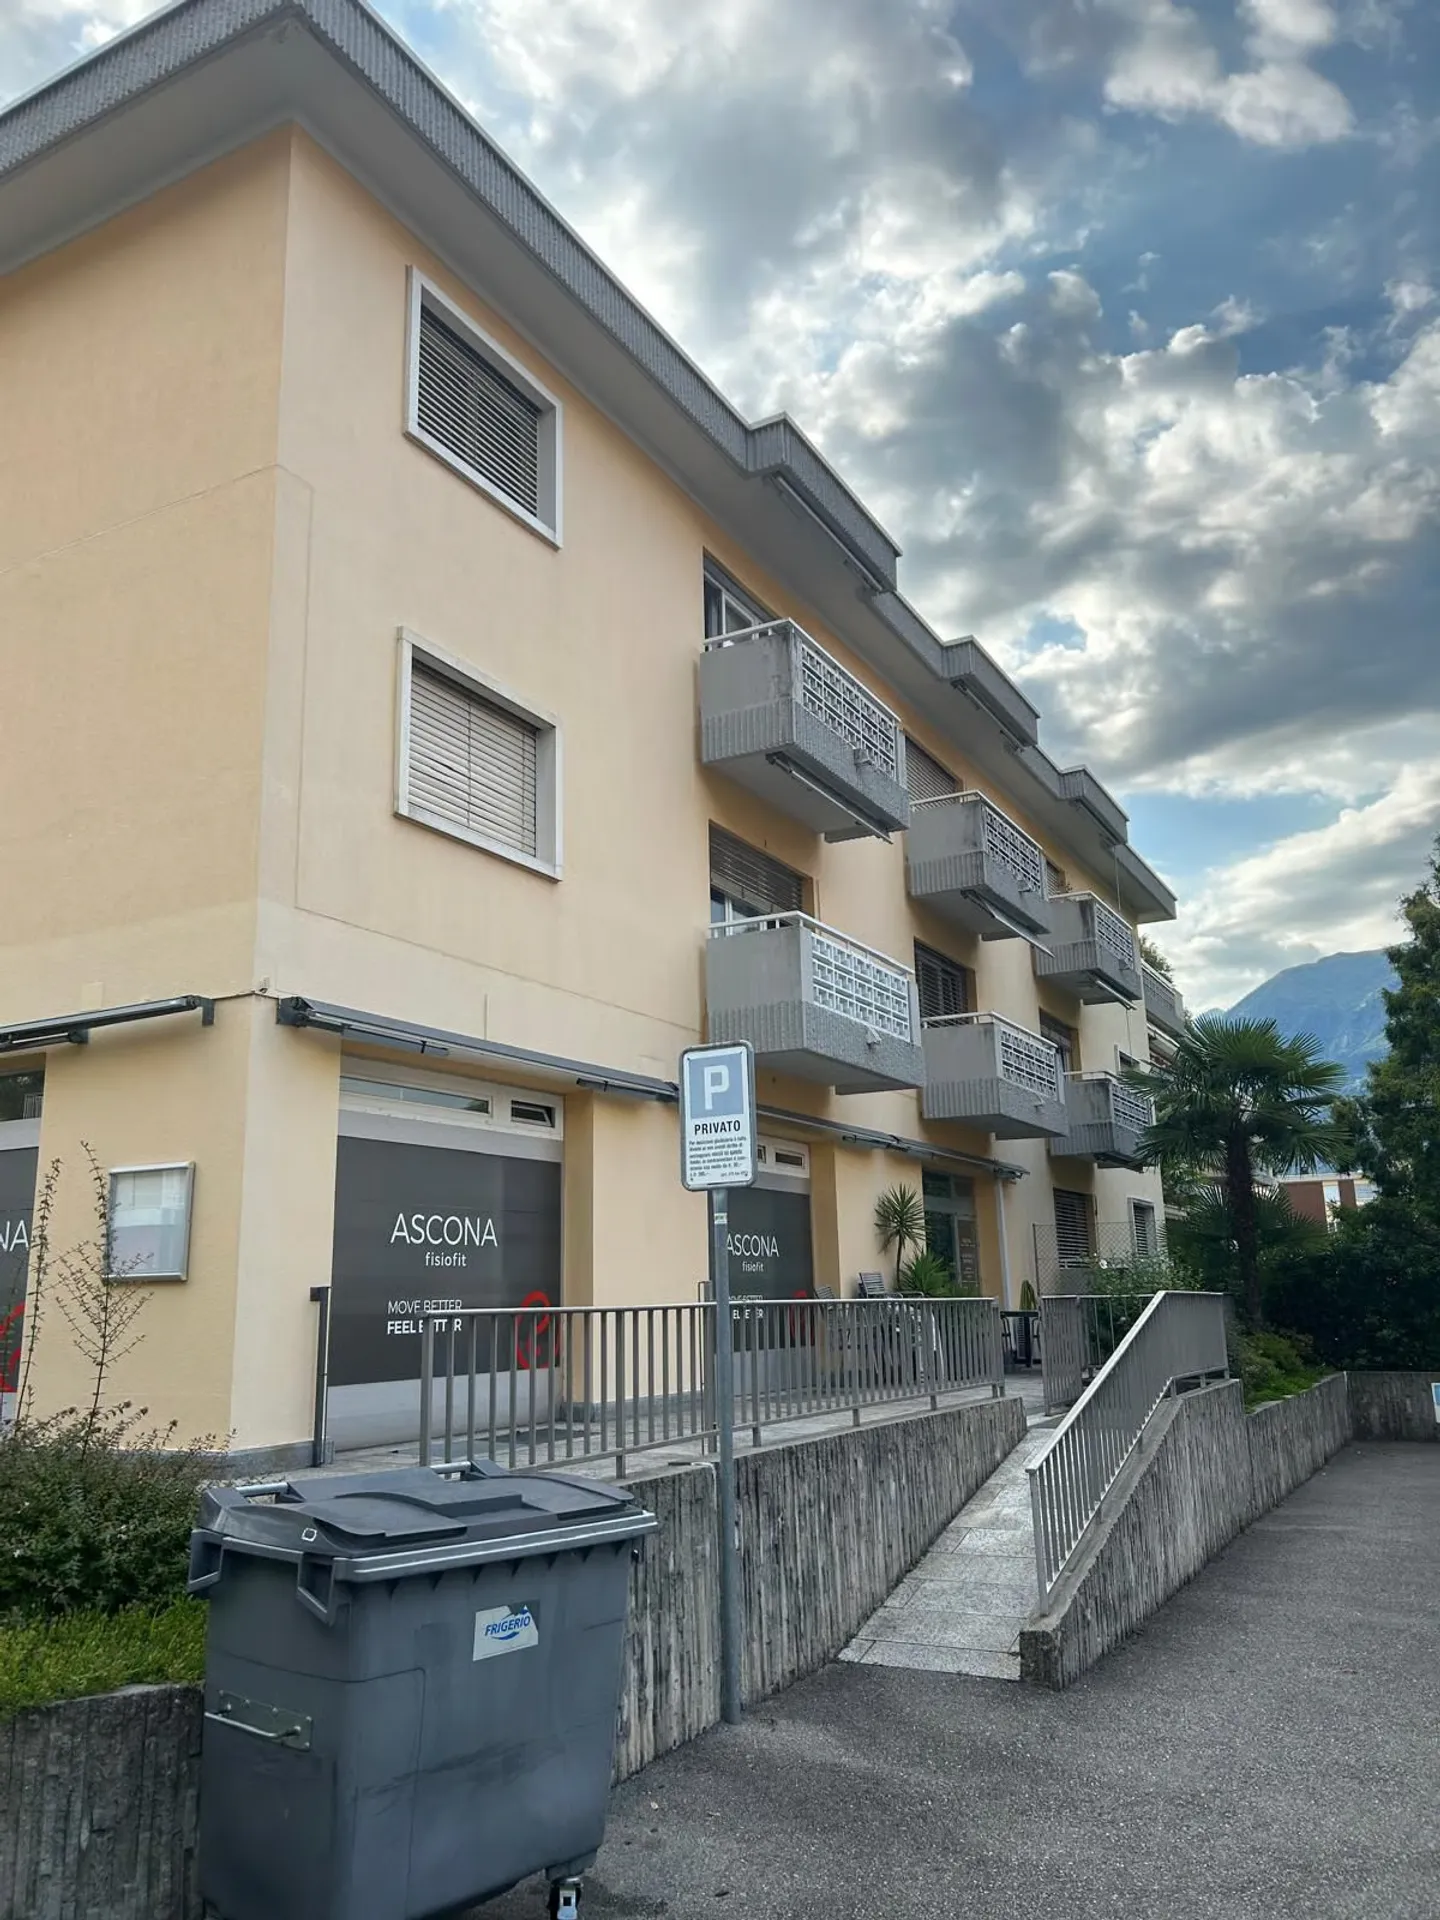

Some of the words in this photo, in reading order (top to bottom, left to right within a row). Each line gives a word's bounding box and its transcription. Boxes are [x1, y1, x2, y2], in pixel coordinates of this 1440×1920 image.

[704, 1064, 730, 1111] P
[694, 1119, 741, 1136] PRIVATO
[390, 1213, 498, 1247] ASCONA
[726, 1233, 780, 1257] ASCONA
[425, 1252, 467, 1267] fisiofit
[742, 1261, 764, 1272] fisiofit
[387, 1300, 421, 1314] MOVE
[423, 1299, 462, 1313] BETTER
[387, 1320, 416, 1335] FEEL
[418, 1318, 462, 1333] BTTR
[484, 1615, 531, 1636] FRIGERIO
